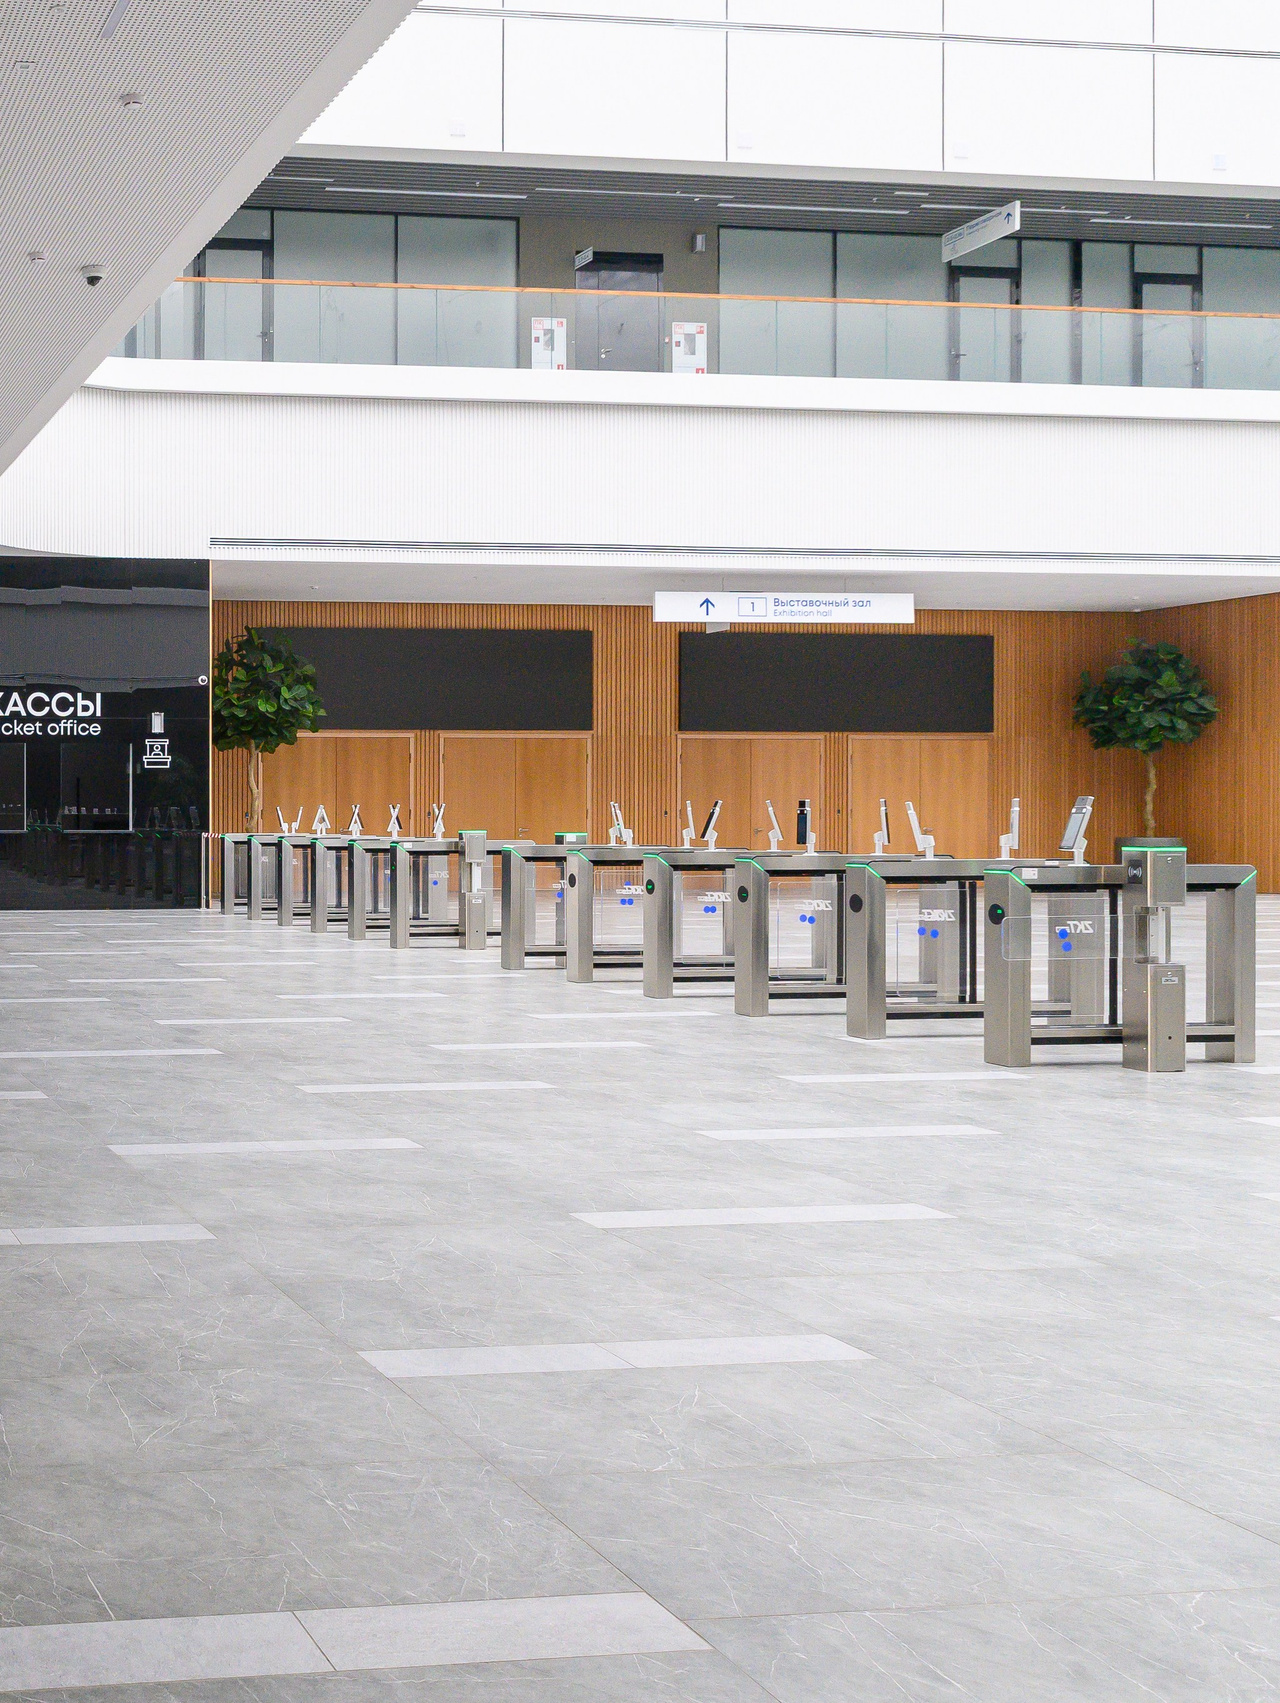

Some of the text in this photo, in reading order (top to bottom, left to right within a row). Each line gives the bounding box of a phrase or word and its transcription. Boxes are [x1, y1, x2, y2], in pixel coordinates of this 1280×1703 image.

[750, 601, 755, 612] 1
[773, 598, 871, 608] Выставочный зал
[773, 608, 833, 617] Exhibition hall
[47, 719, 102, 736] office
